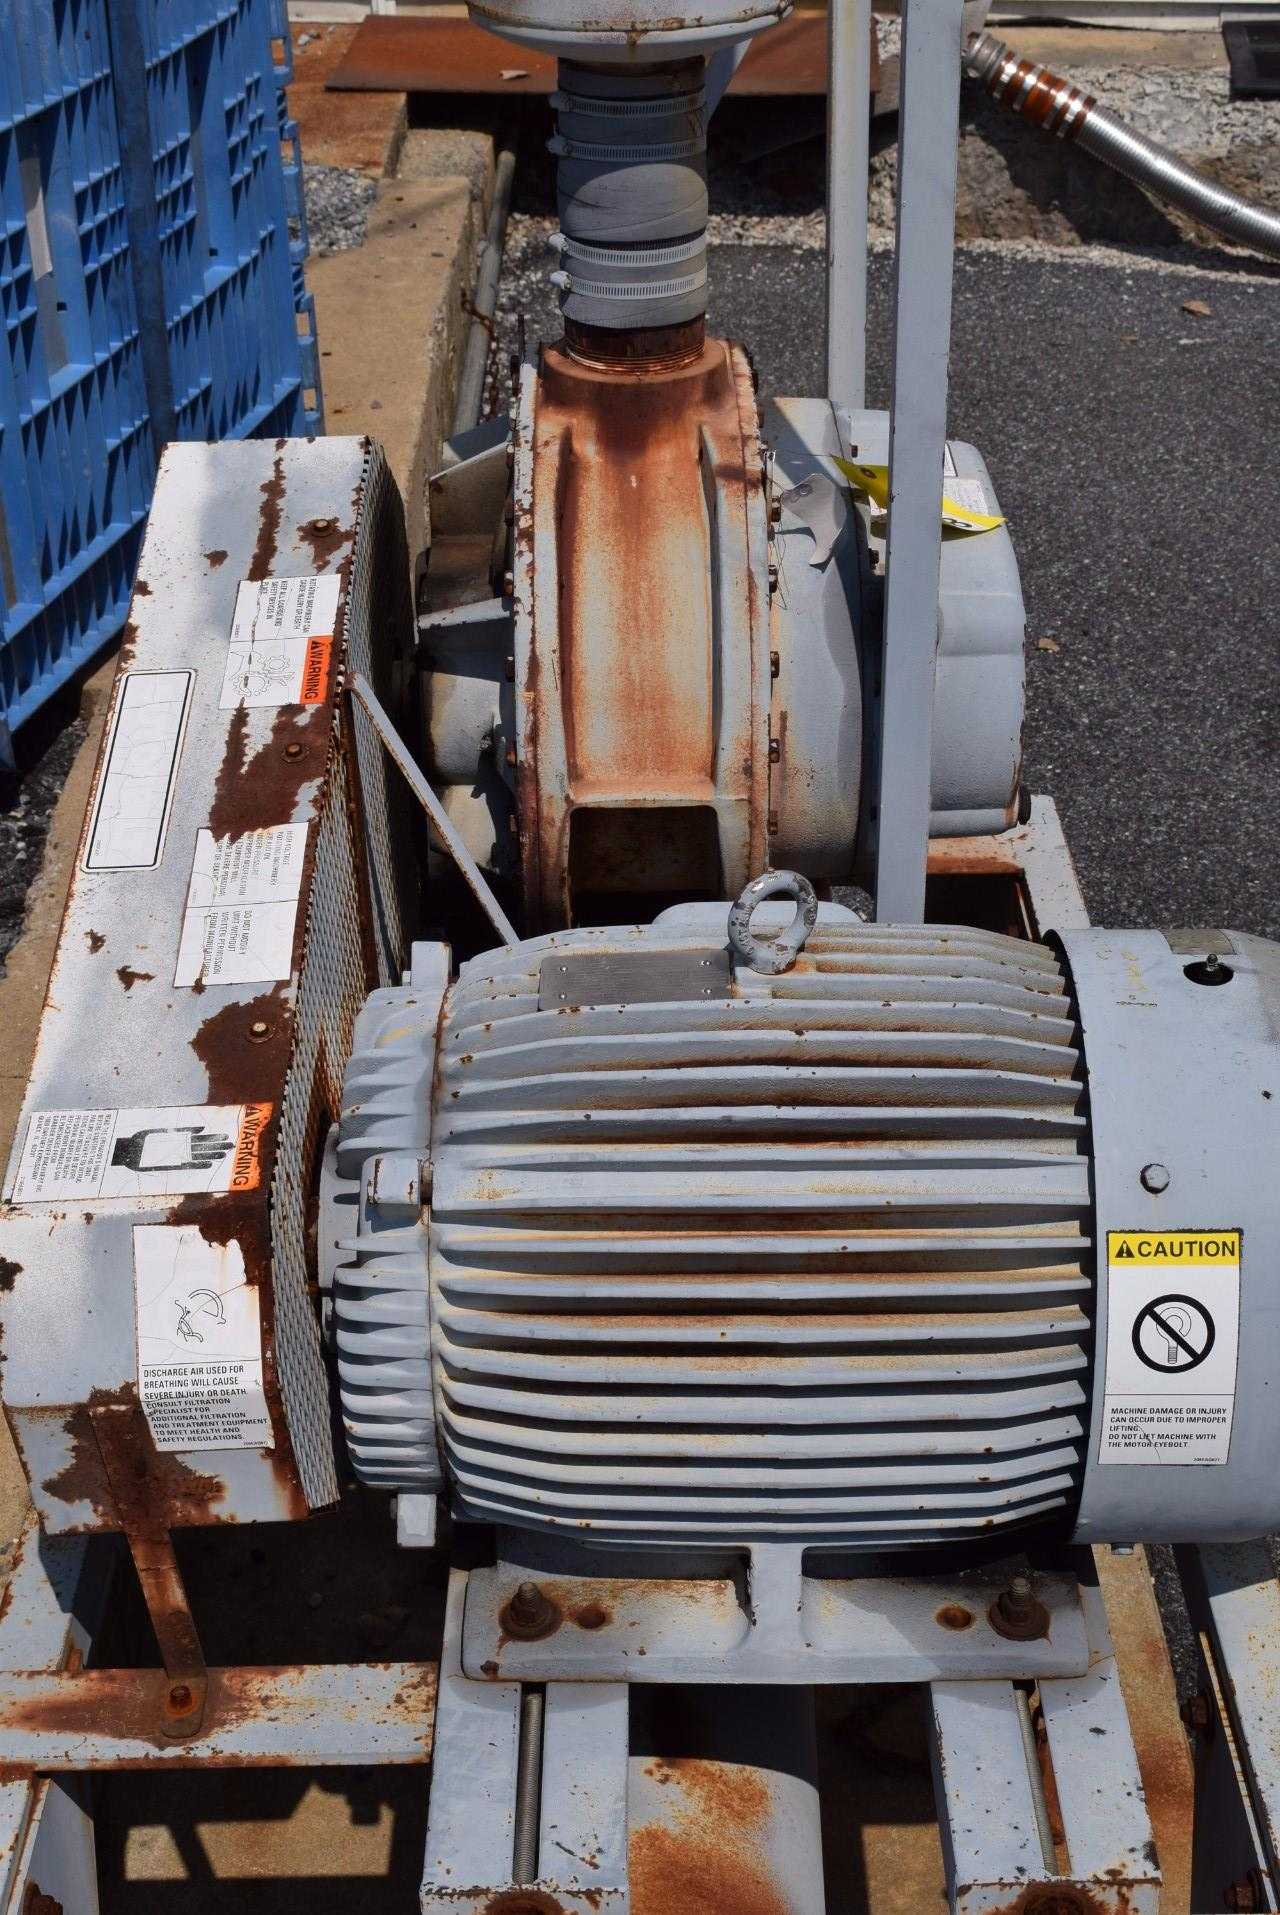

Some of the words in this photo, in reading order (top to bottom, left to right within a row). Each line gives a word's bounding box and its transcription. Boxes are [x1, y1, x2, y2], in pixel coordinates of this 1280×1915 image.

[304, 649, 322, 699] WARNING
[232, 1117, 256, 1187] WARNING
[1137, 1241, 1235, 1257] CAUTION
[144, 1367, 187, 1378] DISCHARGE
[190, 1366, 203, 1376] AIR
[207, 1365, 227, 1375] USED
[230, 1365, 244, 1373] FOR
[144, 1380, 189, 1389] BREATHING
[192, 1379, 209, 1387] WILL
[212, 1378, 238, 1386] CAUSE
[145, 1392, 173, 1400] SEVERE
[175, 1390, 204, 1399] INJURY
[146, 1400, 182, 1409] CONSULT
[1111, 1407, 1147, 1415] MACHINE
[1150, 1407, 1183, 1415] DAMAGE
[1186, 1407, 1196, 1415] OR
[1199, 1407, 1226, 1415] INJURY
[151, 1414, 198, 1422] ADDITIONAL
[172, 1420, 219, 1428] TREATMENT
[222, 1418, 267, 1426] EQUIPMENT
